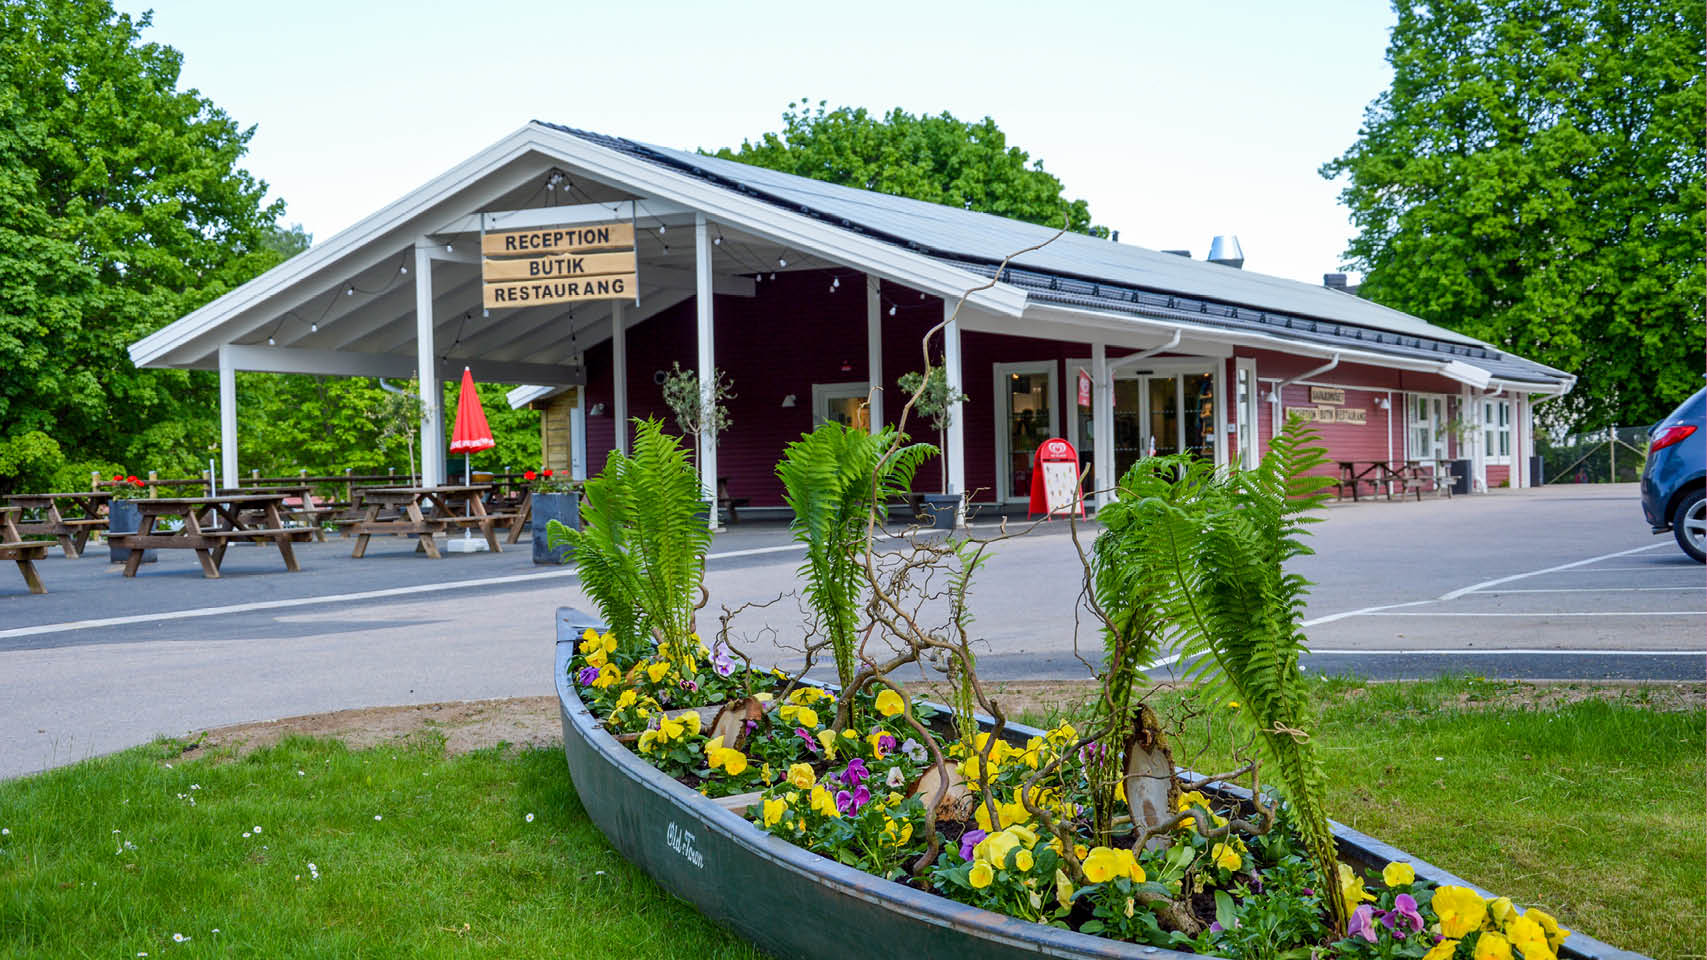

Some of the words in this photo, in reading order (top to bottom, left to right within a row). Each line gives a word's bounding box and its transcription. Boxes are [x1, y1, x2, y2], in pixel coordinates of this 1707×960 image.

[505, 227, 609, 251] RECEPTION
[529, 257, 584, 276] BUTIK
[494, 278, 625, 302] RESTAURANG
[666, 821, 682, 854] Old
